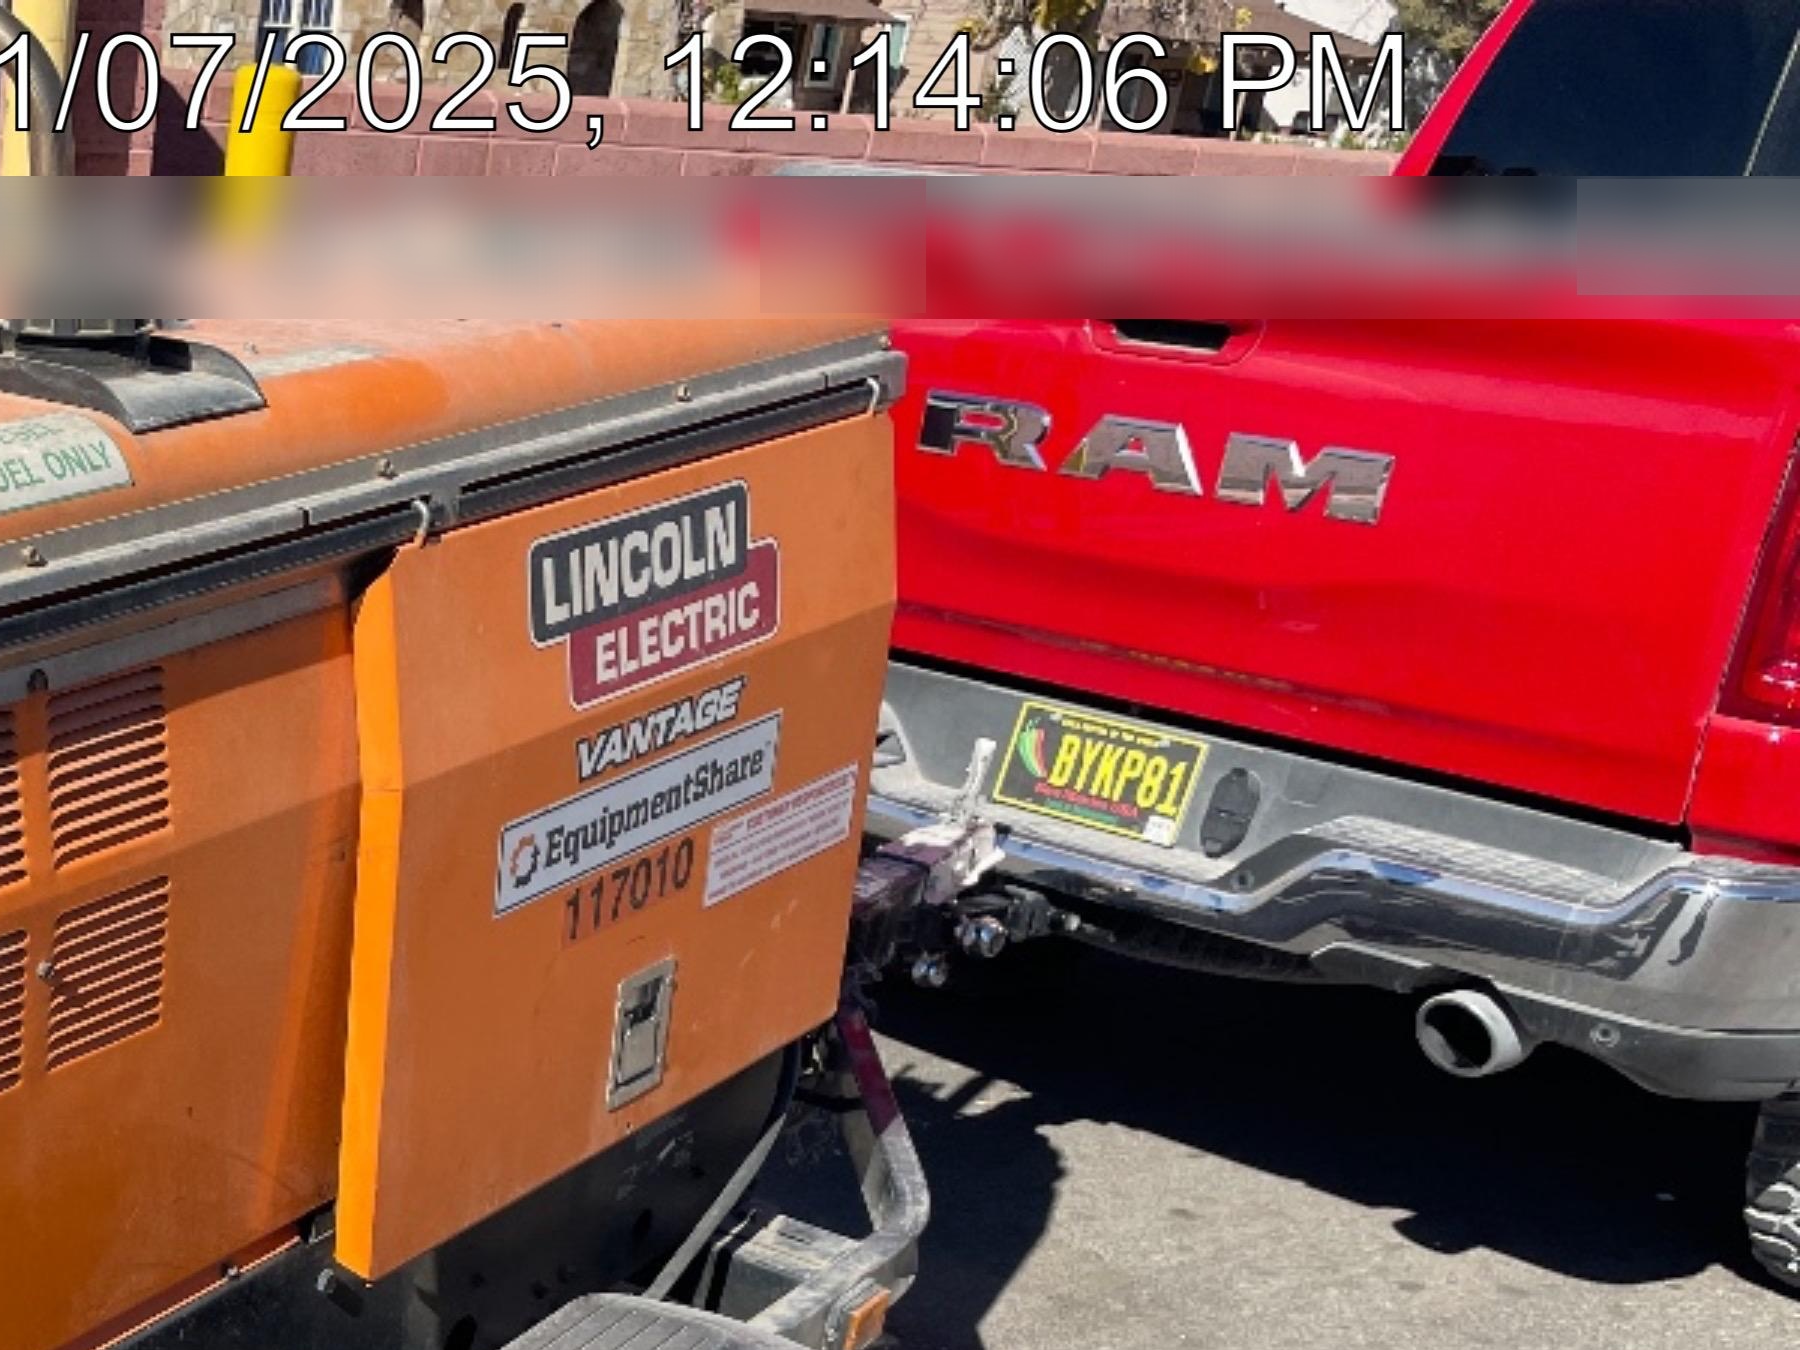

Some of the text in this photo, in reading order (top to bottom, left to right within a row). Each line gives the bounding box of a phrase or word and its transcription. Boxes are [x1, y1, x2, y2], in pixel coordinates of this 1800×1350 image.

[42, 440, 112, 480] ONLY
[916, 389, 1396, 526] RAM
[543, 500, 737, 626] LINCOLN
[596, 581, 761, 684] ELECTRIC
[576, 675, 747, 783] VANTAGE
[1047, 733, 1189, 817] BYKP81
[545, 748, 764, 868] EquipmentShare
[566, 836, 694, 941] 117010
